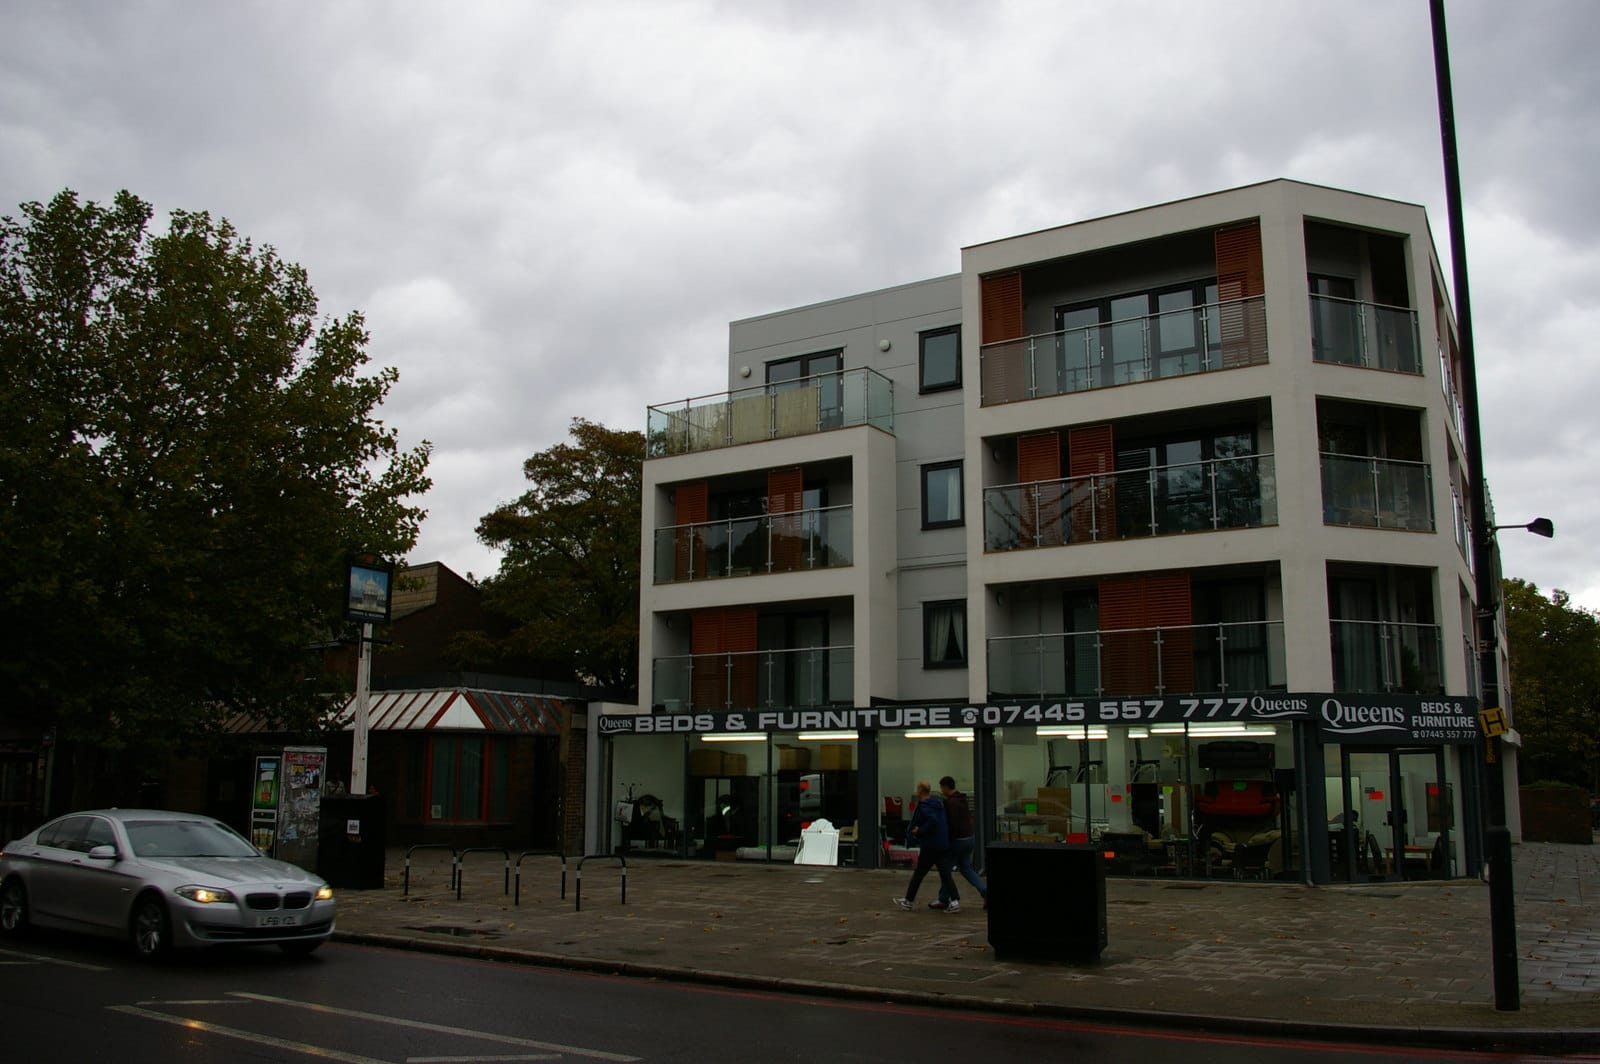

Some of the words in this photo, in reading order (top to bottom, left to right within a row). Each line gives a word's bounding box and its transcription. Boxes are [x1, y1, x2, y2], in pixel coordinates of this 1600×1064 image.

[1251, 695, 1308, 713] Queens
[1420, 702, 1451, 714] BEDS
[1454, 702, 1464, 714] &
[635, 714, 715, 733] BEDS
[725, 713, 747, 731] &
[759, 707, 951, 730] FURNITURE
[983, 702, 1087, 725] 07445
[1099, 700, 1165, 721] 557
[1179, 697, 1250, 718] 777
[1321, 698, 1405, 727] Queens
[599, 716, 632, 731] Queens
[1412, 715, 1475, 728] FURNITURE
[1420, 730, 1444, 739] 07445
[1446, 730, 1461, 739] 557
[1462, 730, 1477, 739] 777
